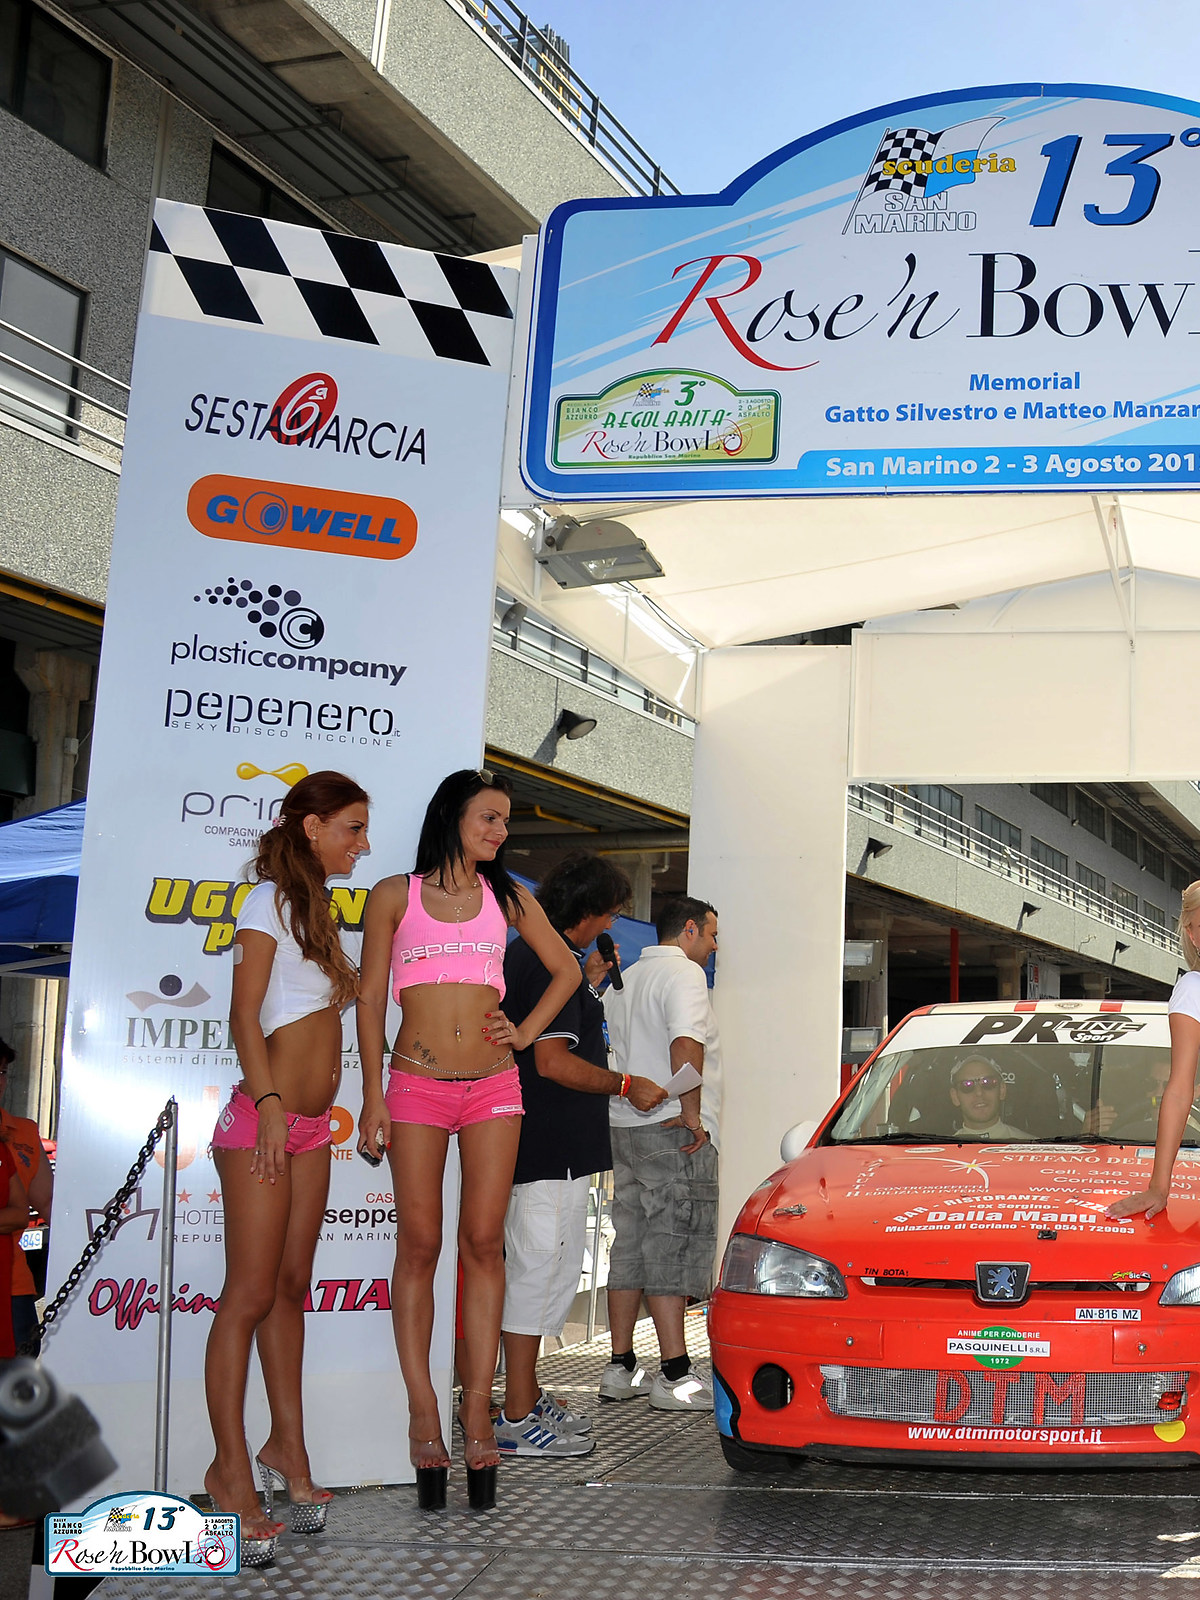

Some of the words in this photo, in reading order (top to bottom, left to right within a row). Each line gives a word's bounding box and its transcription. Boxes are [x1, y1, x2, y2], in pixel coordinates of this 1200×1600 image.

[881, 153, 1017, 177] scuderia
[884, 190, 948, 212] SAN
[853, 211, 977, 235] MARINO
[968, 371, 1081, 392] Memorial
[674, 380, 706, 407] 3°
[824, 404, 890, 423] Gatto
[895, 402, 998, 422] Silvestro
[1003, 406, 1017, 420] e
[1022, 400, 1107, 420] Matteo
[826, 457, 874, 477] San
[882, 454, 978, 476] Marino
[984, 455, 1000, 474] 2
[1022, 454, 1038, 473] 3
[1044, 453, 1142, 479] Agosto
[206, 490, 402, 546] GOWELL
[170, 634, 408, 686] plasticcompany
[171, 720, 217, 732] SEXY
[233, 725, 289, 738] DISCO
[305, 732, 393, 748] RICCIONE
[1073, 1032, 1115, 1043] Sport
[122, 1053, 184, 1065] sistemi
[192, 1054, 208, 1066] di
[1001, 1154, 1100, 1164] STEFANO
[1106, 1156, 1149, 1166] DEL
[1040, 1168, 1081, 1176] Cell.
[1053, 1176, 1130, 1186] Coriano
[893, 1206, 929, 1223] BAR
[943, 1194, 1051, 1207] RISTORANTE
[926, 1210, 1003, 1223] Dalla
[1012, 1210, 1096, 1224] Manu
[885, 1224, 954, 1233] Mulazzano
[970, 1223, 1018, 1231] Coriano
[1054, 1223, 1084, 1232] 0541
[864, 1268, 879, 1276] TIN
[1122, 1310, 1139, 1320] MZ
[958, 1329, 982, 1338] ANIME
[984, 1330, 999, 1338] PER
[1001, 1331, 1041, 1339] FONDERIE
[949, 1342, 1028, 1353] PASQUINELLI
[990, 1357, 1010, 1365] 1972
[933, 1370, 1087, 1426] DTM
[907, 1426, 1103, 1446] www.dtmmotorsport.it
